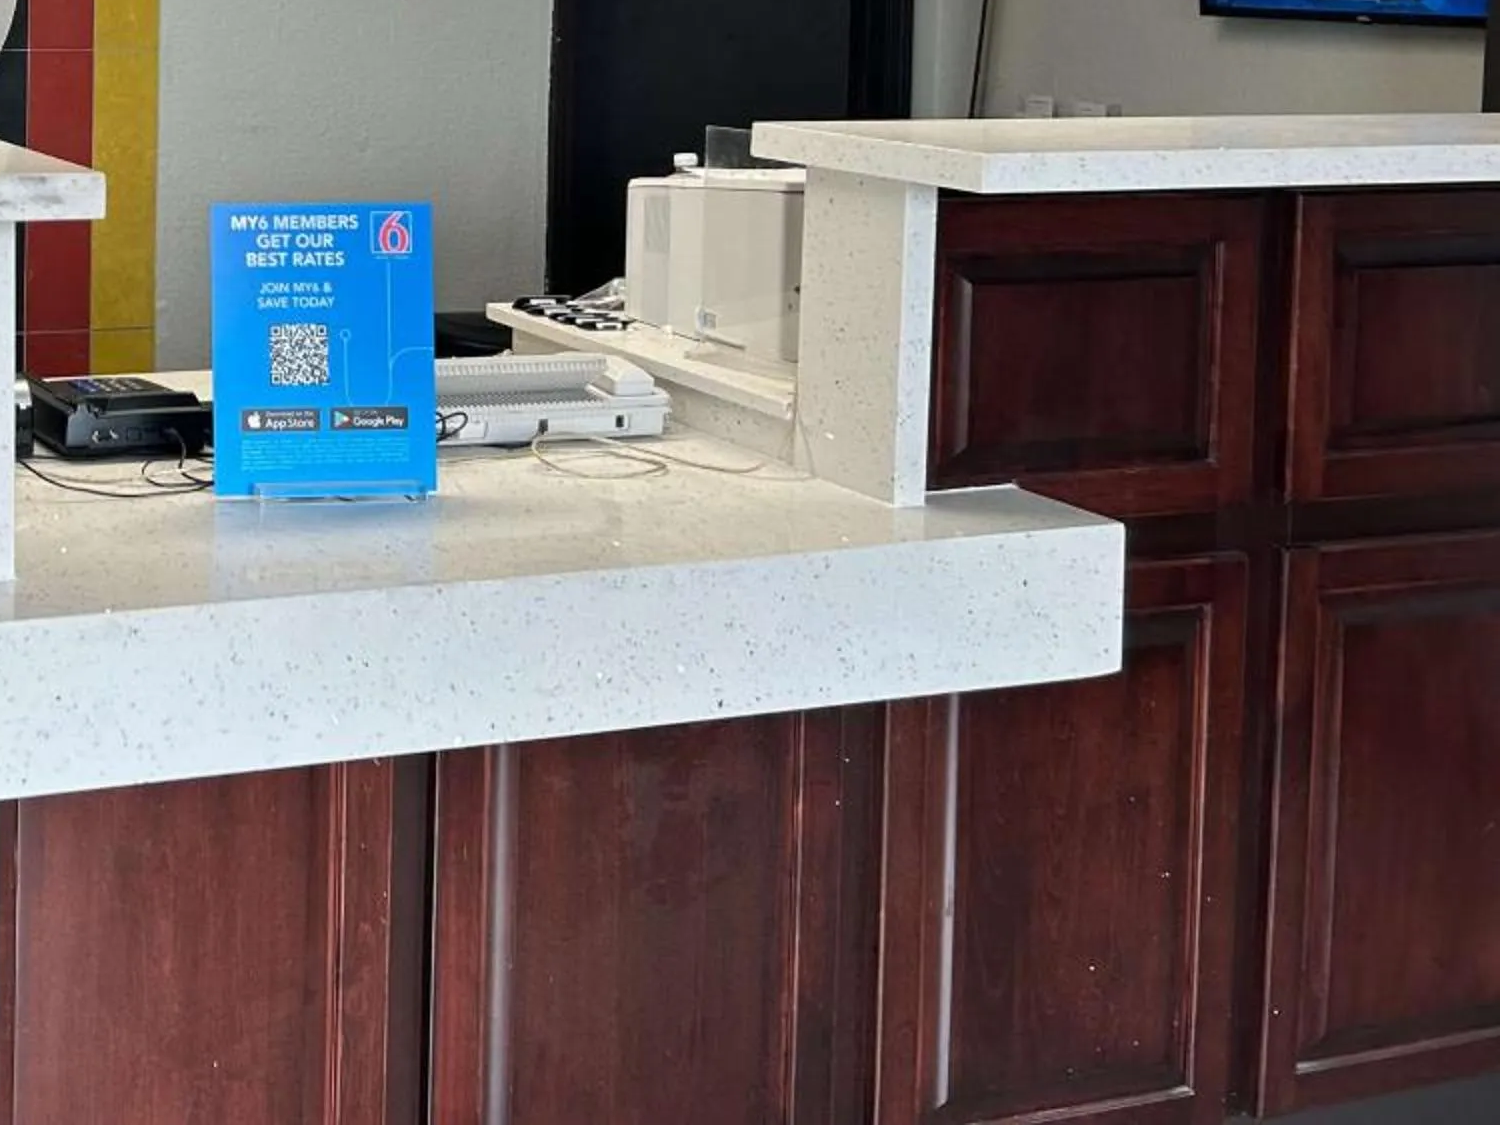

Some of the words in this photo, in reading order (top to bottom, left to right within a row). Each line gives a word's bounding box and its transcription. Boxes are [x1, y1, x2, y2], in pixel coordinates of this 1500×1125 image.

[231, 214, 268, 231] MY6
[273, 214, 359, 230] MEMBERS
[378, 211, 409, 254] 6
[256, 233, 292, 249] GET
[295, 233, 334, 248] OUR
[246, 251, 288, 268] BEST
[293, 251, 345, 267] RATES
[260, 282, 290, 294] JOIN
[257, 296, 289, 310] SAVE
[292, 295, 335, 309] TODAY
[265, 418, 286, 431] App
[287, 417, 315, 429] Store
[353, 416, 384, 428] Google
[385, 415, 405, 427] Play
